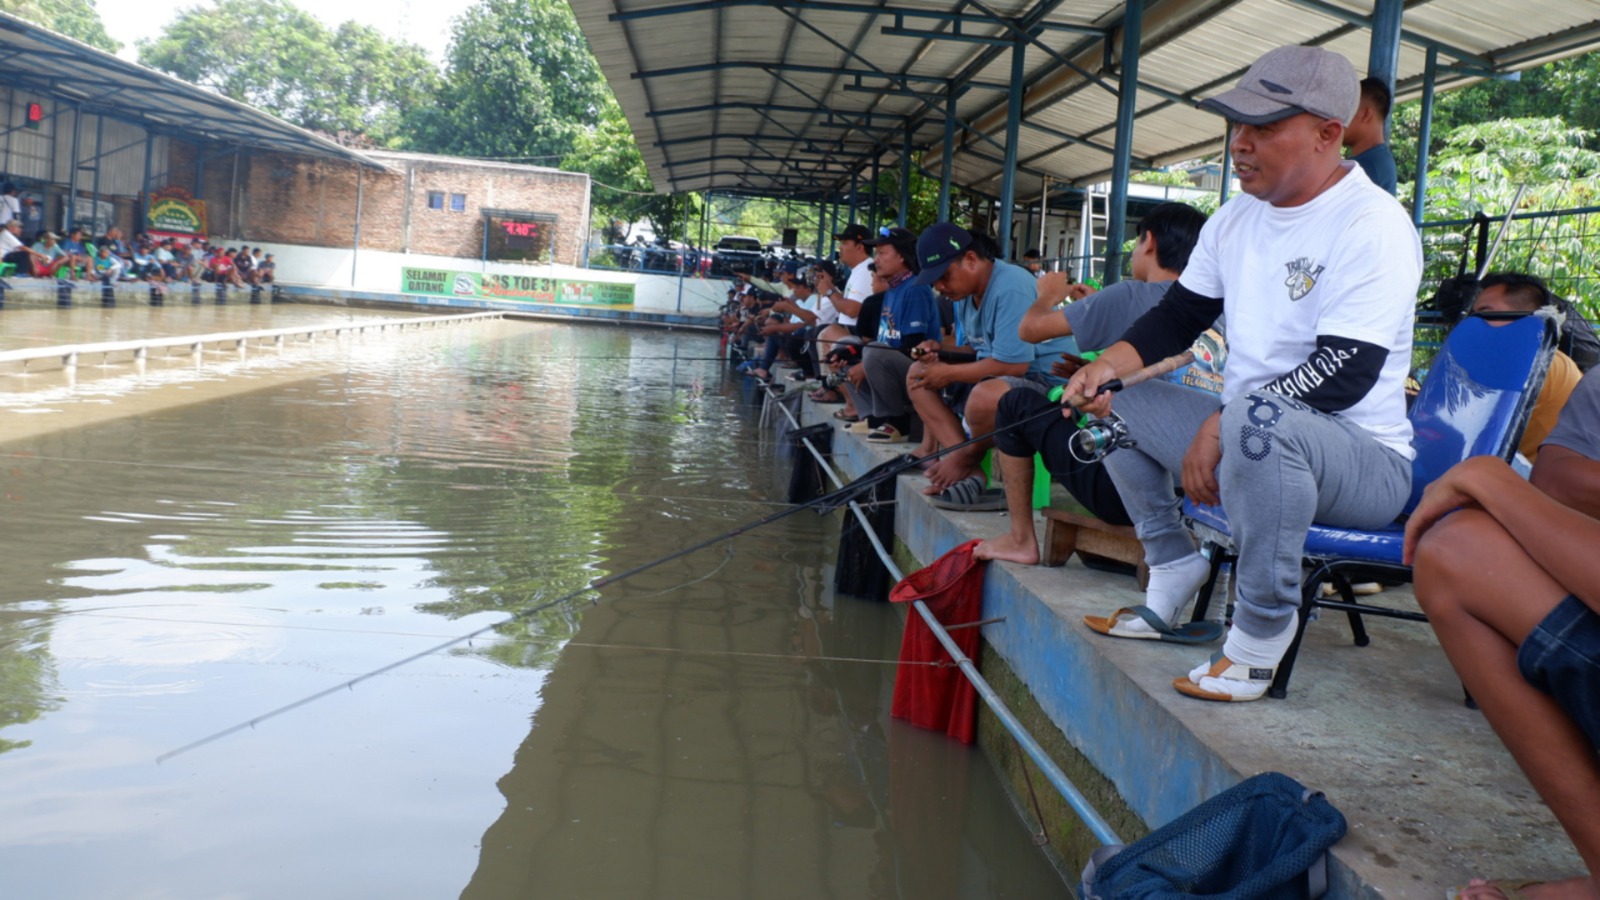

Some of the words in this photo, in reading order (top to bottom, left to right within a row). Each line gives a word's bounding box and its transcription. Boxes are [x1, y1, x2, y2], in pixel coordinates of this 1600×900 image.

[406, 269, 448, 282] SELAMAT
[408, 280, 445, 293] DATANG
[513, 275, 539, 291] TOE
[541, 278, 558, 292] 31
